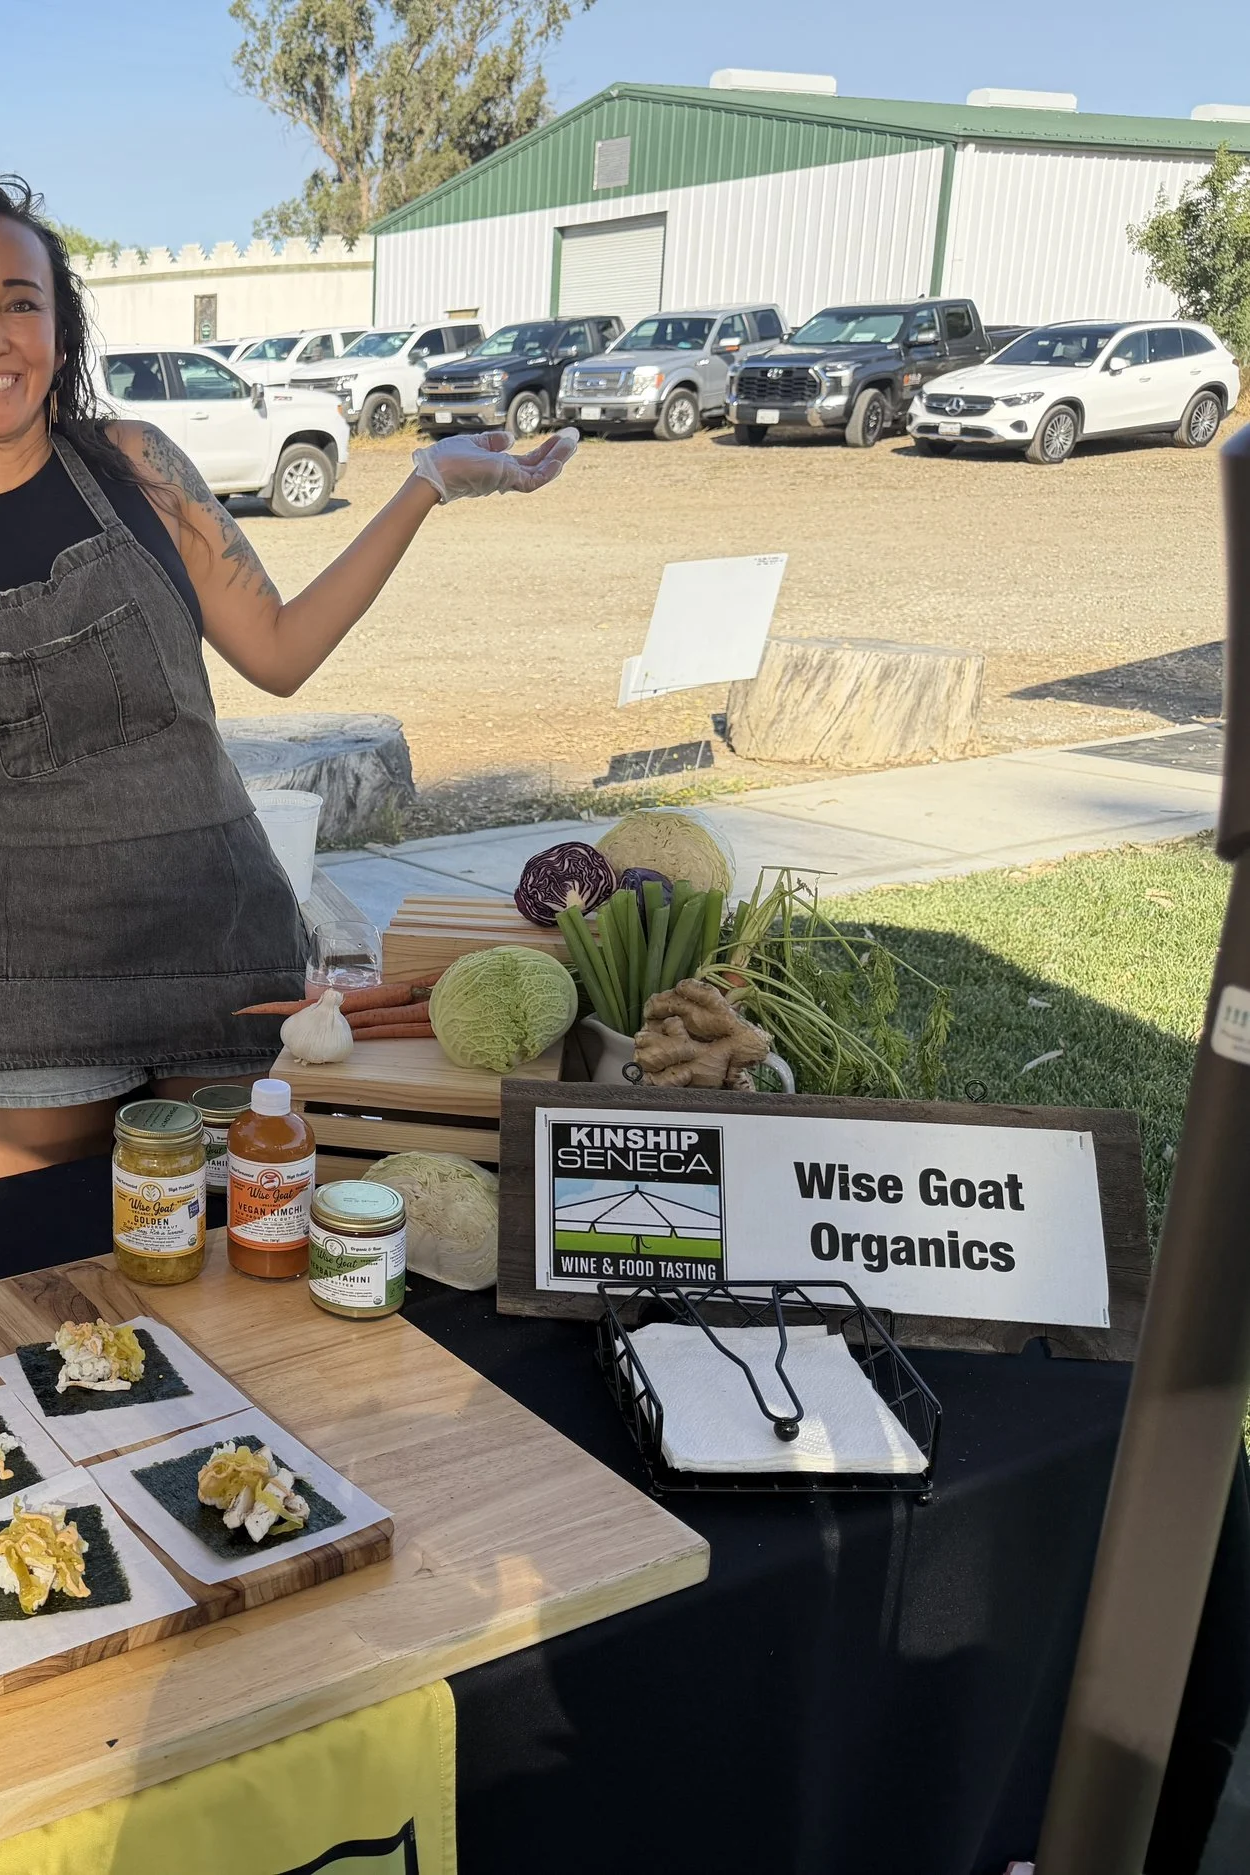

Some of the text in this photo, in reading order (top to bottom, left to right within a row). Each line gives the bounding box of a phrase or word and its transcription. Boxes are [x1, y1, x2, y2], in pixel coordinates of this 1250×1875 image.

[570, 1126, 699, 1151] KINSHIP
[558, 1148, 713, 1175] SENECA
[247, 1186, 294, 1202] Wise Goat
[793, 1161, 1025, 1211] Wise Goat
[129, 1198, 150, 1211] Wise
[153, 1202, 174, 1216] Goat
[238, 1202, 302, 1216] VEGAN KIMCHI
[134, 1215, 169, 1226] GOLDEN
[810, 1222, 1016, 1273] Organics
[316, 1248, 332, 1263] Wise
[336, 1256, 358, 1268] Goat
[338, 1274, 370, 1283] TAHINI
[561, 1256, 716, 1281] WINE & FOOD TASTING
